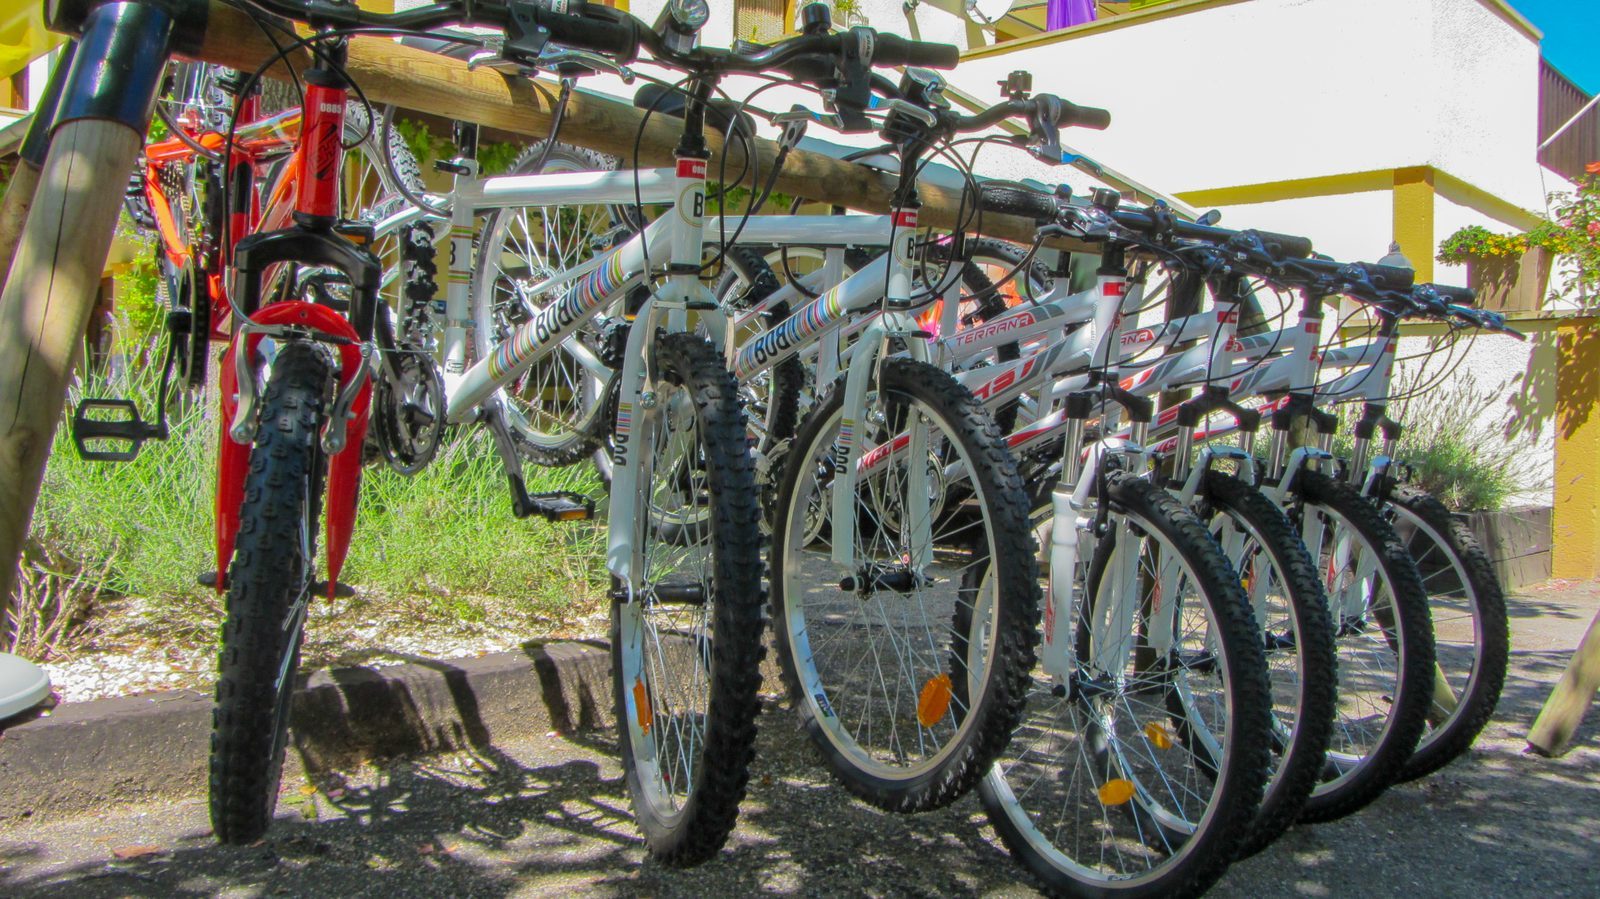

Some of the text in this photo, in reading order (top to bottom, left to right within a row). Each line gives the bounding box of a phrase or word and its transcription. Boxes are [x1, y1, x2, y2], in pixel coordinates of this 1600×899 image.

[693, 192, 704, 217] B
[536, 292, 573, 344] BOB
[956, 313, 1031, 346] TERRANA
[754, 322, 791, 364] BOB
